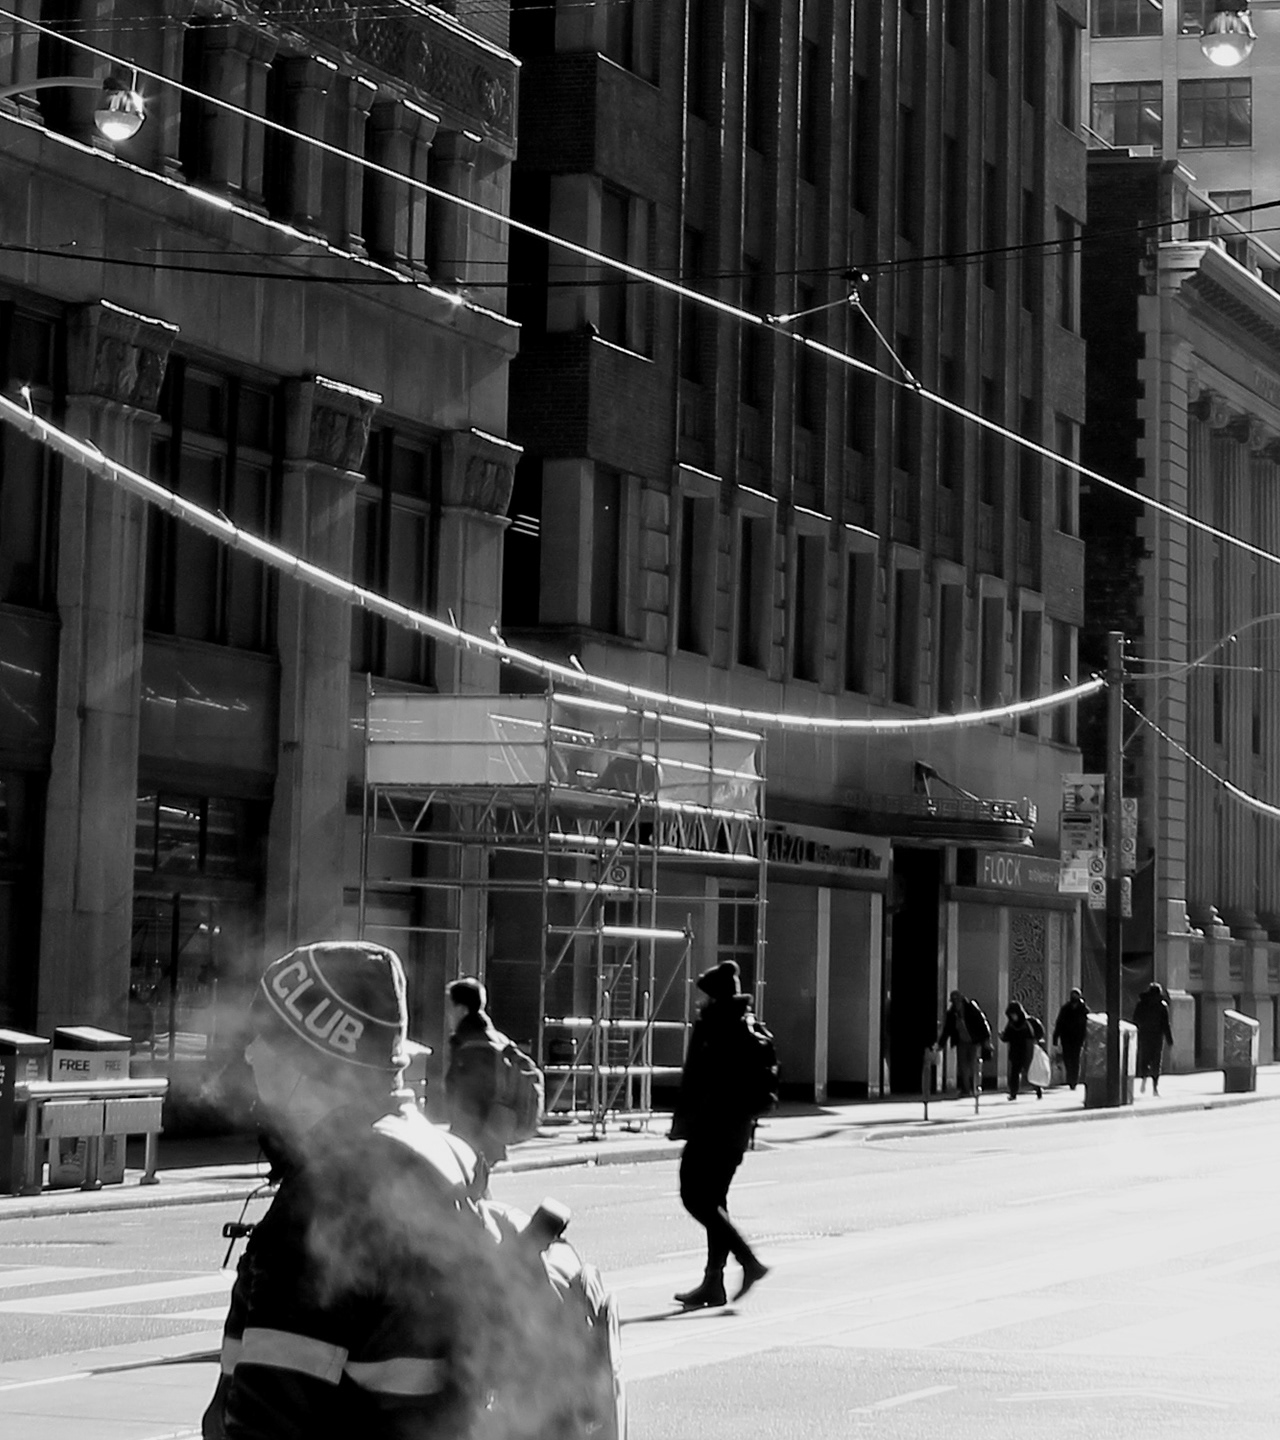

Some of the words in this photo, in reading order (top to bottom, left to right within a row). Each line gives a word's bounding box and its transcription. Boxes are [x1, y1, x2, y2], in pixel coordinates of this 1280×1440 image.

[984, 855, 1022, 886] FLOCK
[272, 960, 365, 1054] CLUB
[59, 1059, 91, 1072] FREE
